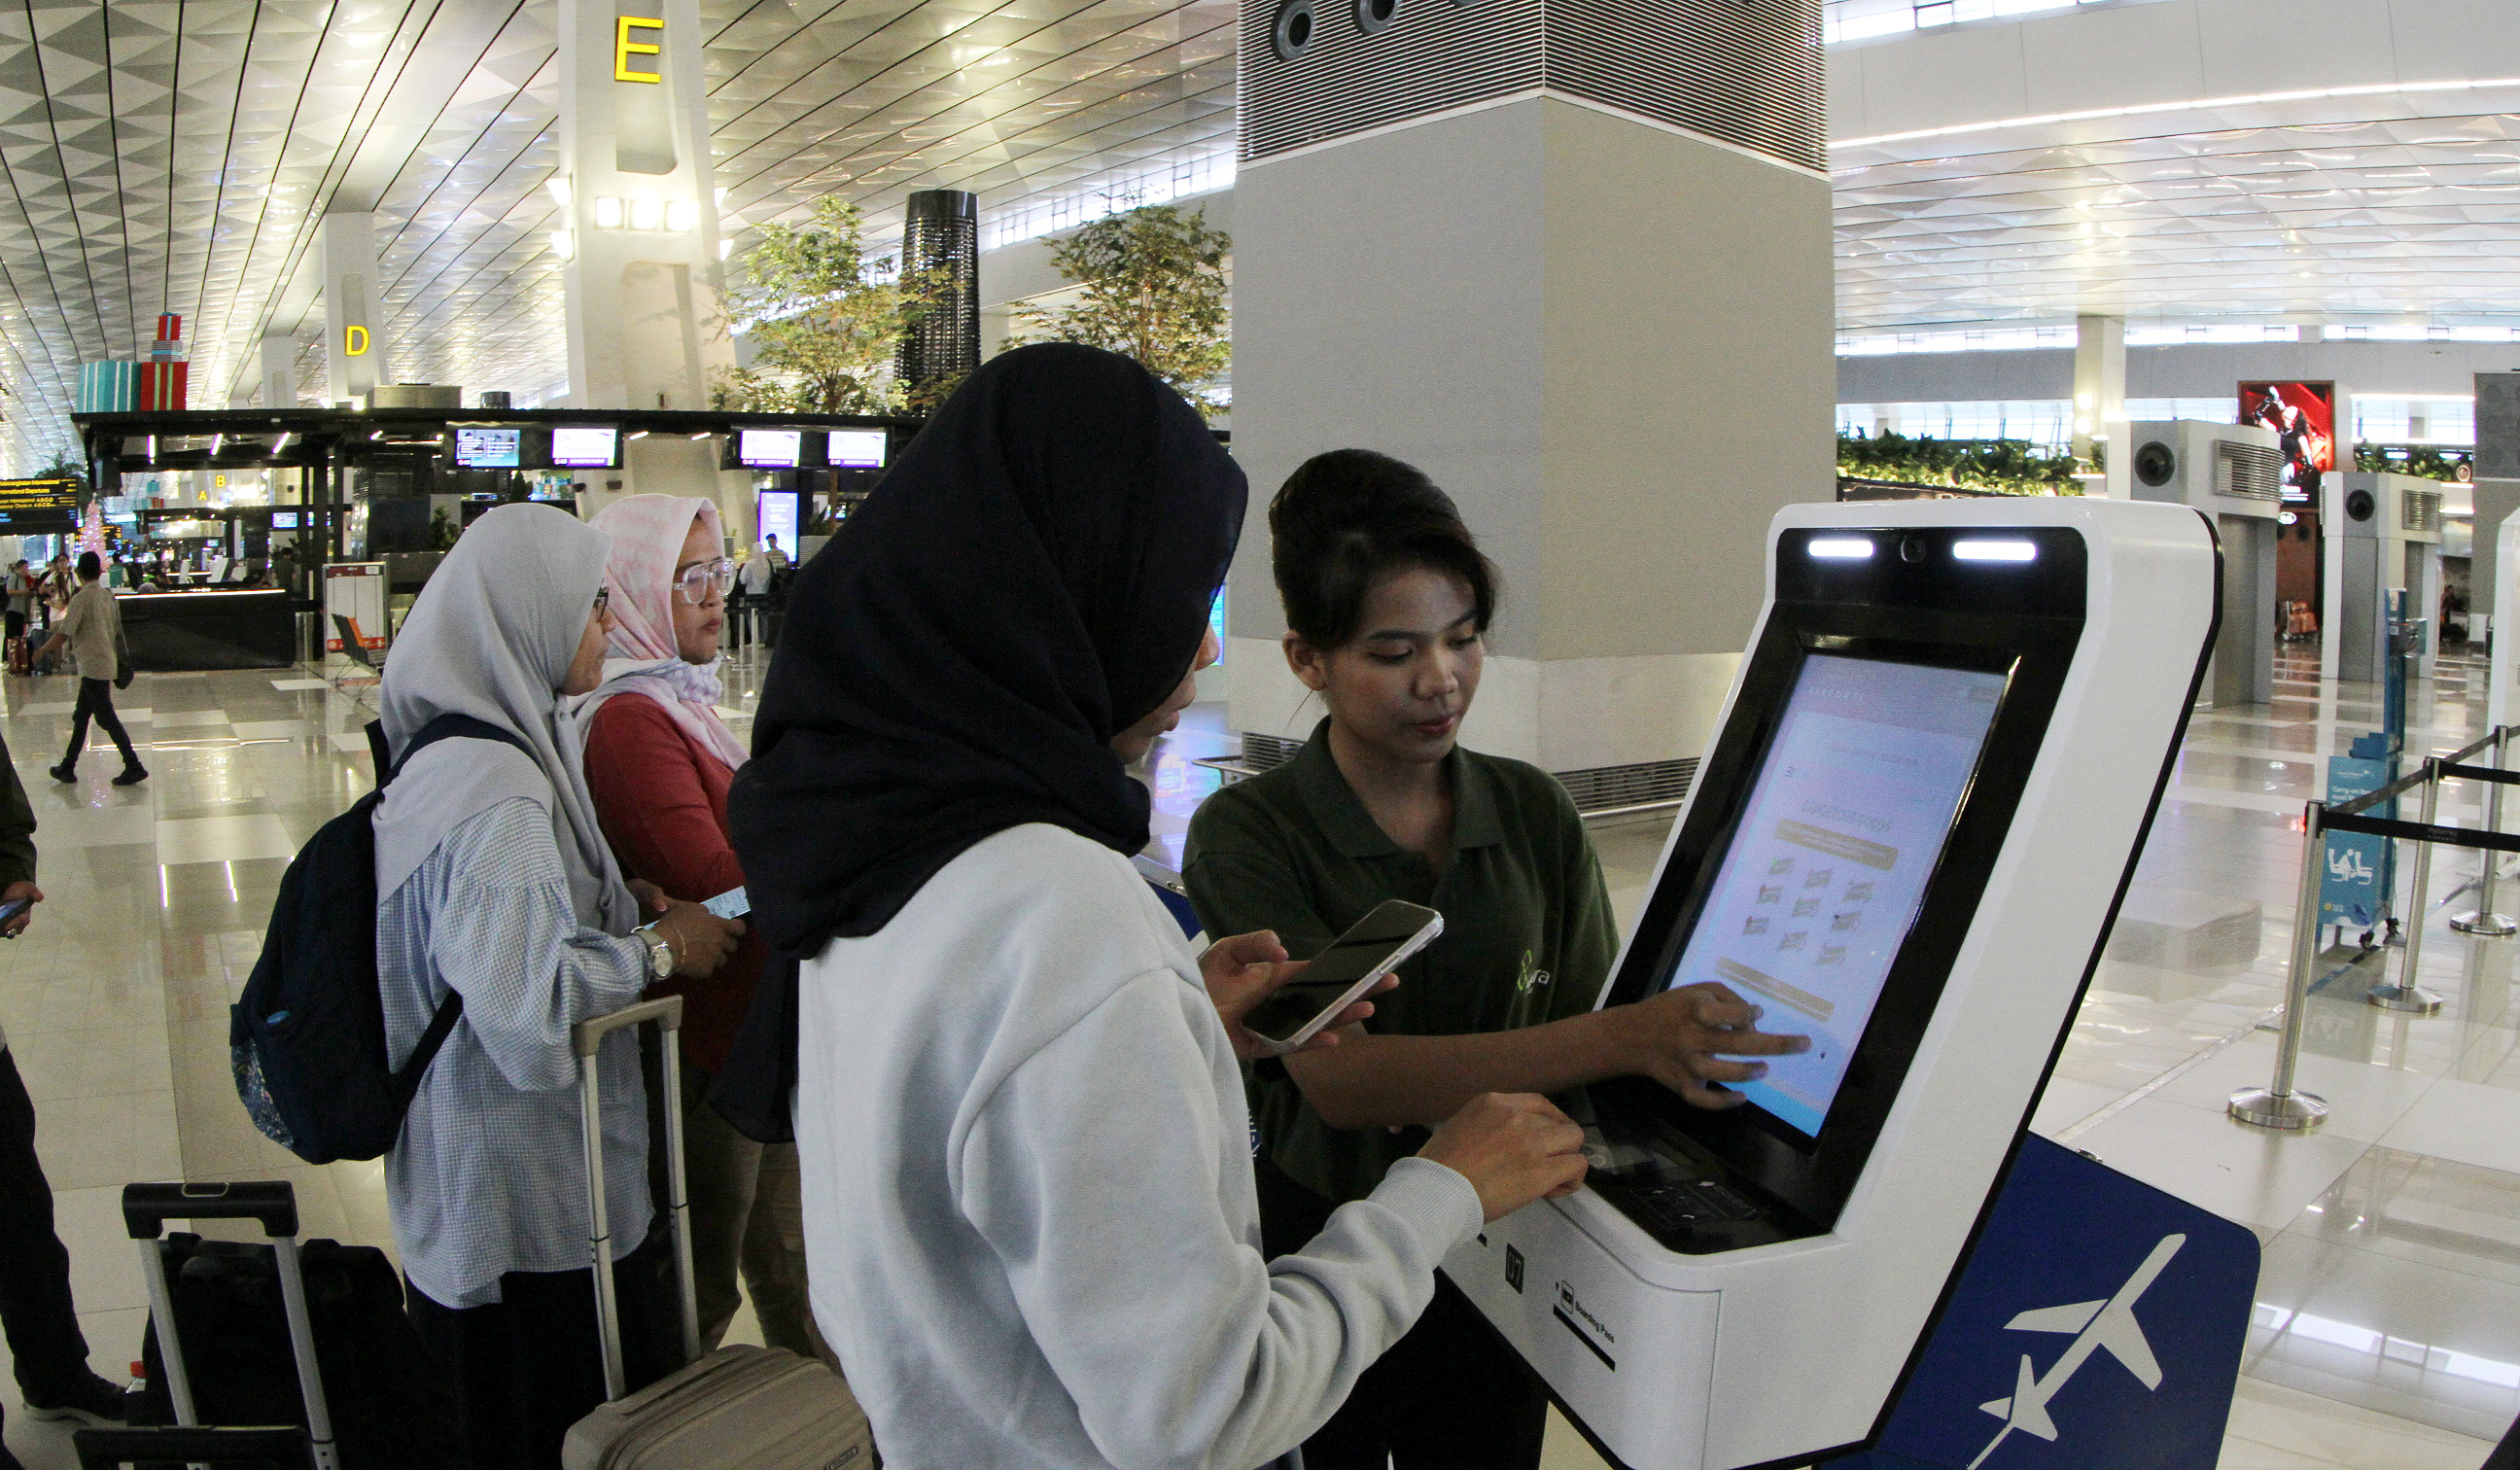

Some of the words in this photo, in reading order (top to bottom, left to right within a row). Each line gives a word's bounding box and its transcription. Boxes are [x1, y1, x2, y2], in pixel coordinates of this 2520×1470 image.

[614, 16, 664, 84] E
[346, 325, 369, 356] D
[216, 474, 226, 487] B
[197, 490, 207, 501] A
